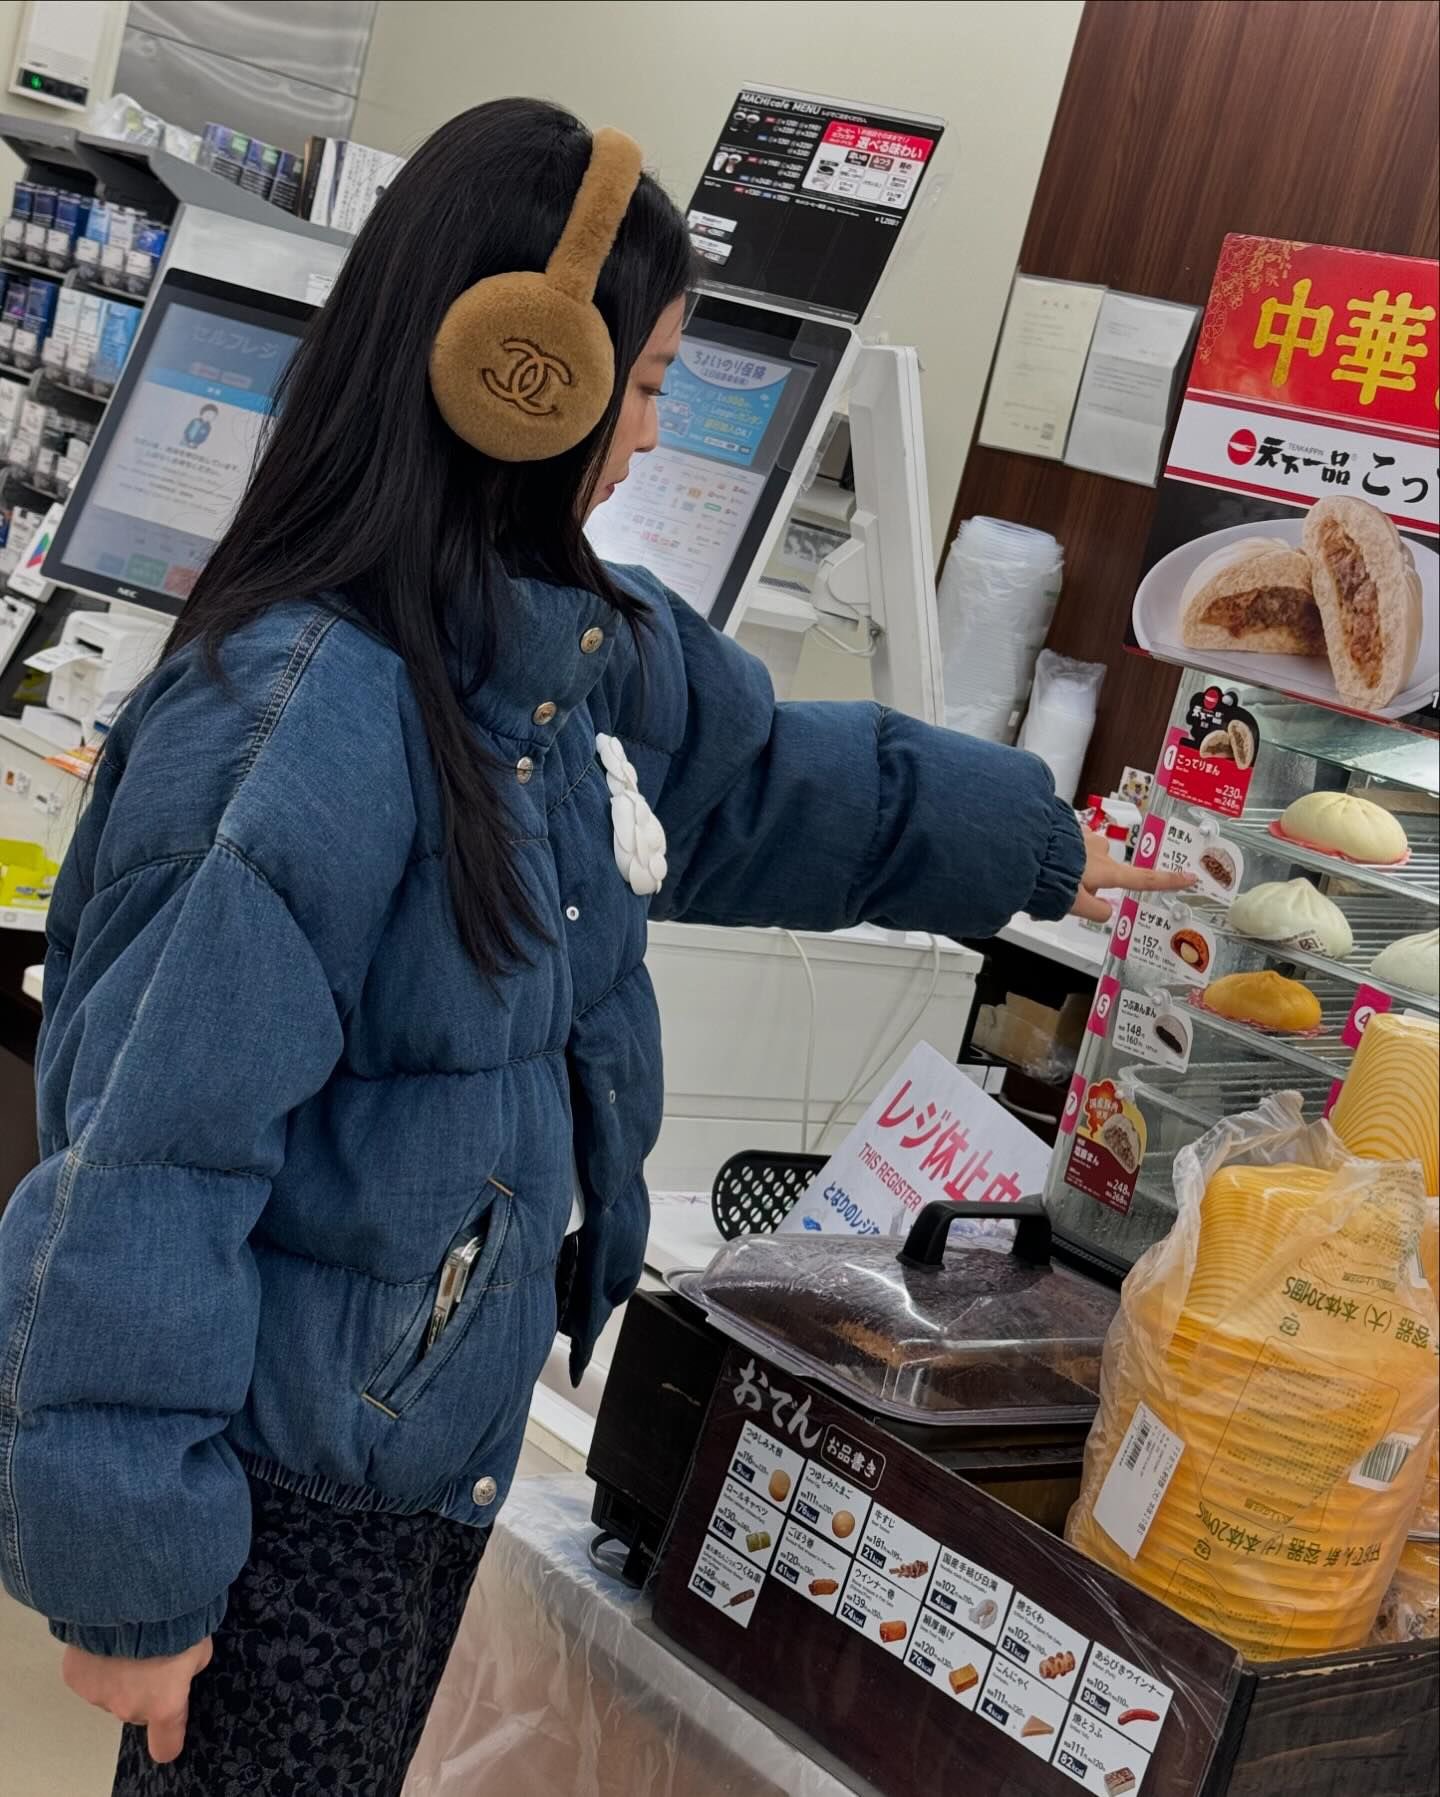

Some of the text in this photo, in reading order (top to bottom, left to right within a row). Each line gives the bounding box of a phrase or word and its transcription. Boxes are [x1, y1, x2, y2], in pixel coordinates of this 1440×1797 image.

[792, 101, 821, 115] MENU
[1253, 278, 1439, 410] 中華
[1255, 436, 1350, 486] 天下一品
[117, 586, 138, 598] NEC
[1177, 754, 1220, 776] こってりまん
[1222, 784, 1241, 799] 230
[1143, 836, 1152, 854] 2
[1168, 826, 1192, 844] 肉まん
[1171, 850, 1188, 865] 157
[1118, 919, 1128, 937] 3
[1140, 911, 1171, 930] ピザまん
[1142, 935, 1160, 949] 157
[1099, 998, 1108, 1015] 5
[1126, 1022, 1142, 1037] 148
[876, 1079, 1022, 1203] レジ休止中
[858, 1142, 922, 1212] THIS REGISTER
[1395, 1316, 1430, 1349] 容器
[733, 1358, 823, 1449] おでん
[826, 1436, 877, 1478] お品書き
[726, 1483, 768, 1516] ロールキャベツ
[875, 1509, 896, 1528] 牛すじ
[863, 1547, 884, 1567] 21kcal
[1287, 1536, 1322, 1565] 容器
[855, 1568, 895, 1600] ウインナー巻
[935, 1594, 952, 1611] 4kcal
[1016, 1599, 1044, 1625] 焼ちくわ
[842, 1604, 864, 1626] 74kcal
[1003, 1638, 1026, 1660] 31kcal
[911, 1651, 933, 1675] 76kcal
[1094, 1650, 1165, 1698] あらびきウインナー
[995, 1661, 1030, 1691] こんにゃく
[985, 1703, 1003, 1721] 4kcal
[1082, 1689, 1108, 1713] 98kcal
[1072, 1712, 1103, 1738] 焼とうふ
[1060, 1752, 1084, 1778] 82kcal
